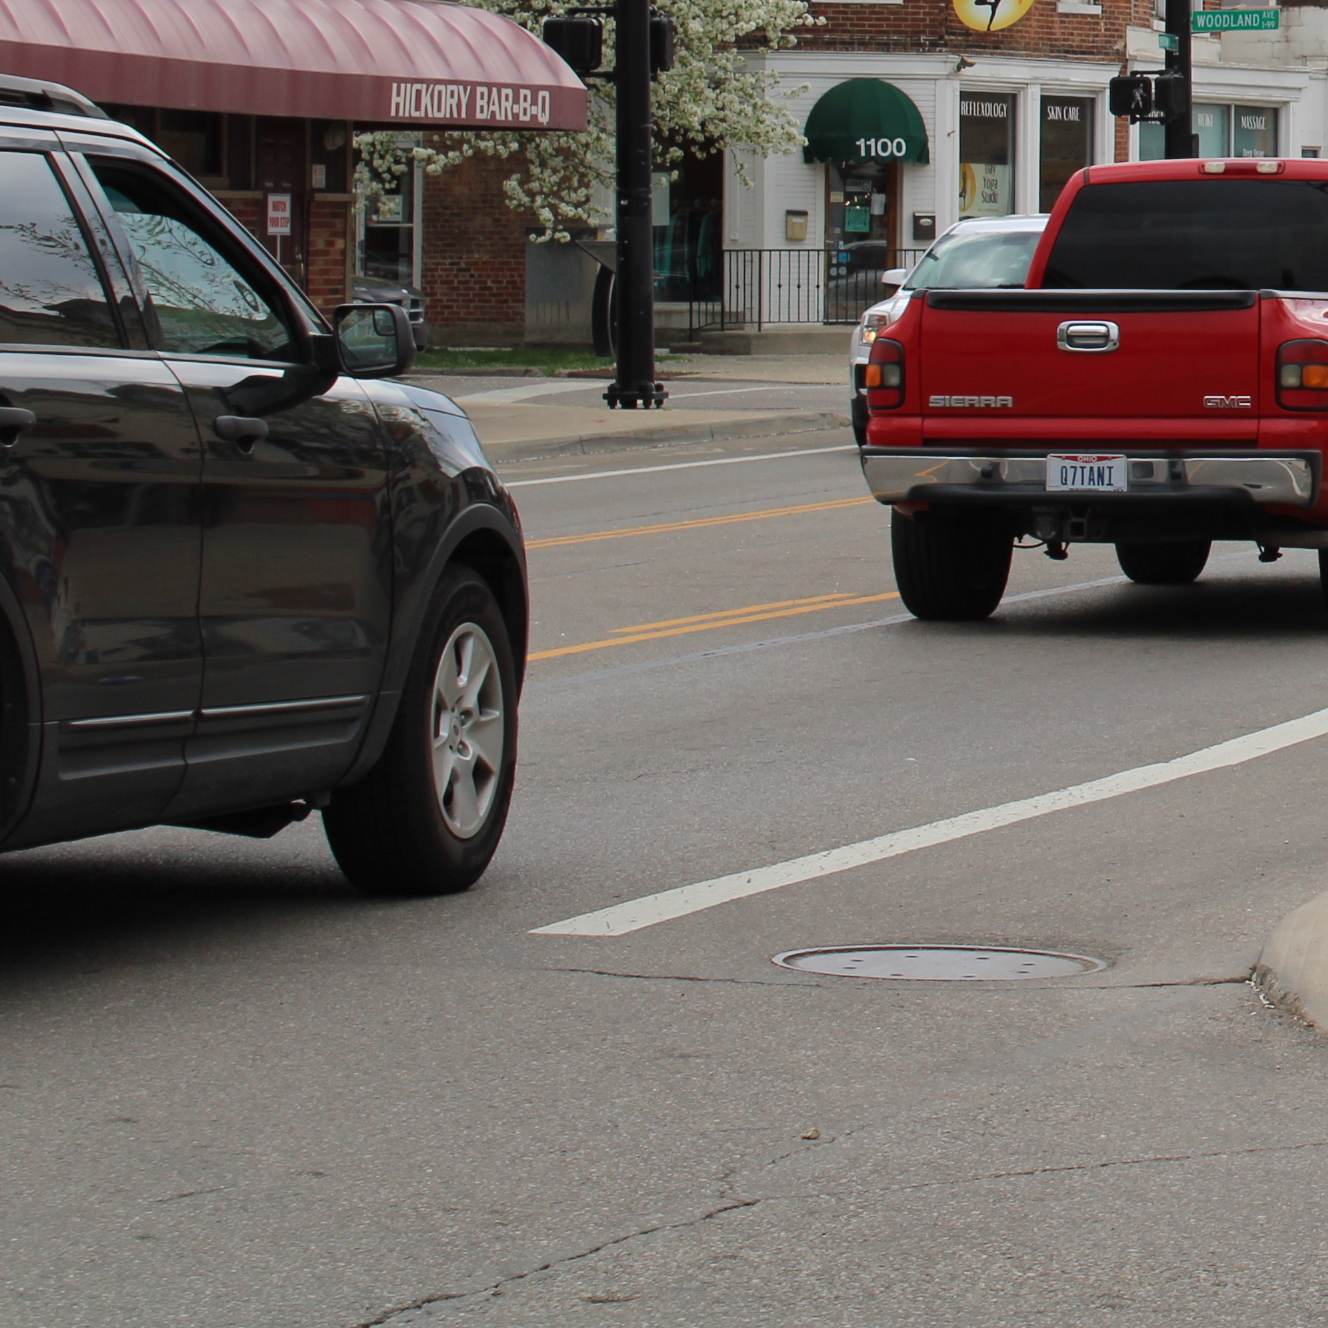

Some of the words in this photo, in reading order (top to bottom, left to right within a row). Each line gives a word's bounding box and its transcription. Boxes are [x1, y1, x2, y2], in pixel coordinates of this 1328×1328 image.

[1196, 14, 1260, 27] WOODLAND
[1262, 11, 1275, 19] AVE
[390, 82, 471, 119] HICKORY
[475, 85, 550, 126] BAR-B-Q
[960, 101, 1008, 118] REFLEXOLOGY
[1047, 106, 1062, 120] SKIN
[1063, 107, 1080, 122] CARE
[1241, 115, 1267, 130] MASSAGE
[855, 137, 907, 158] 1100
[983, 176, 998, 191] Yoga
[981, 190, 998, 204] Studio
[929, 395, 1014, 408] SIERRA
[1203, 395, 1252, 409] GMC
